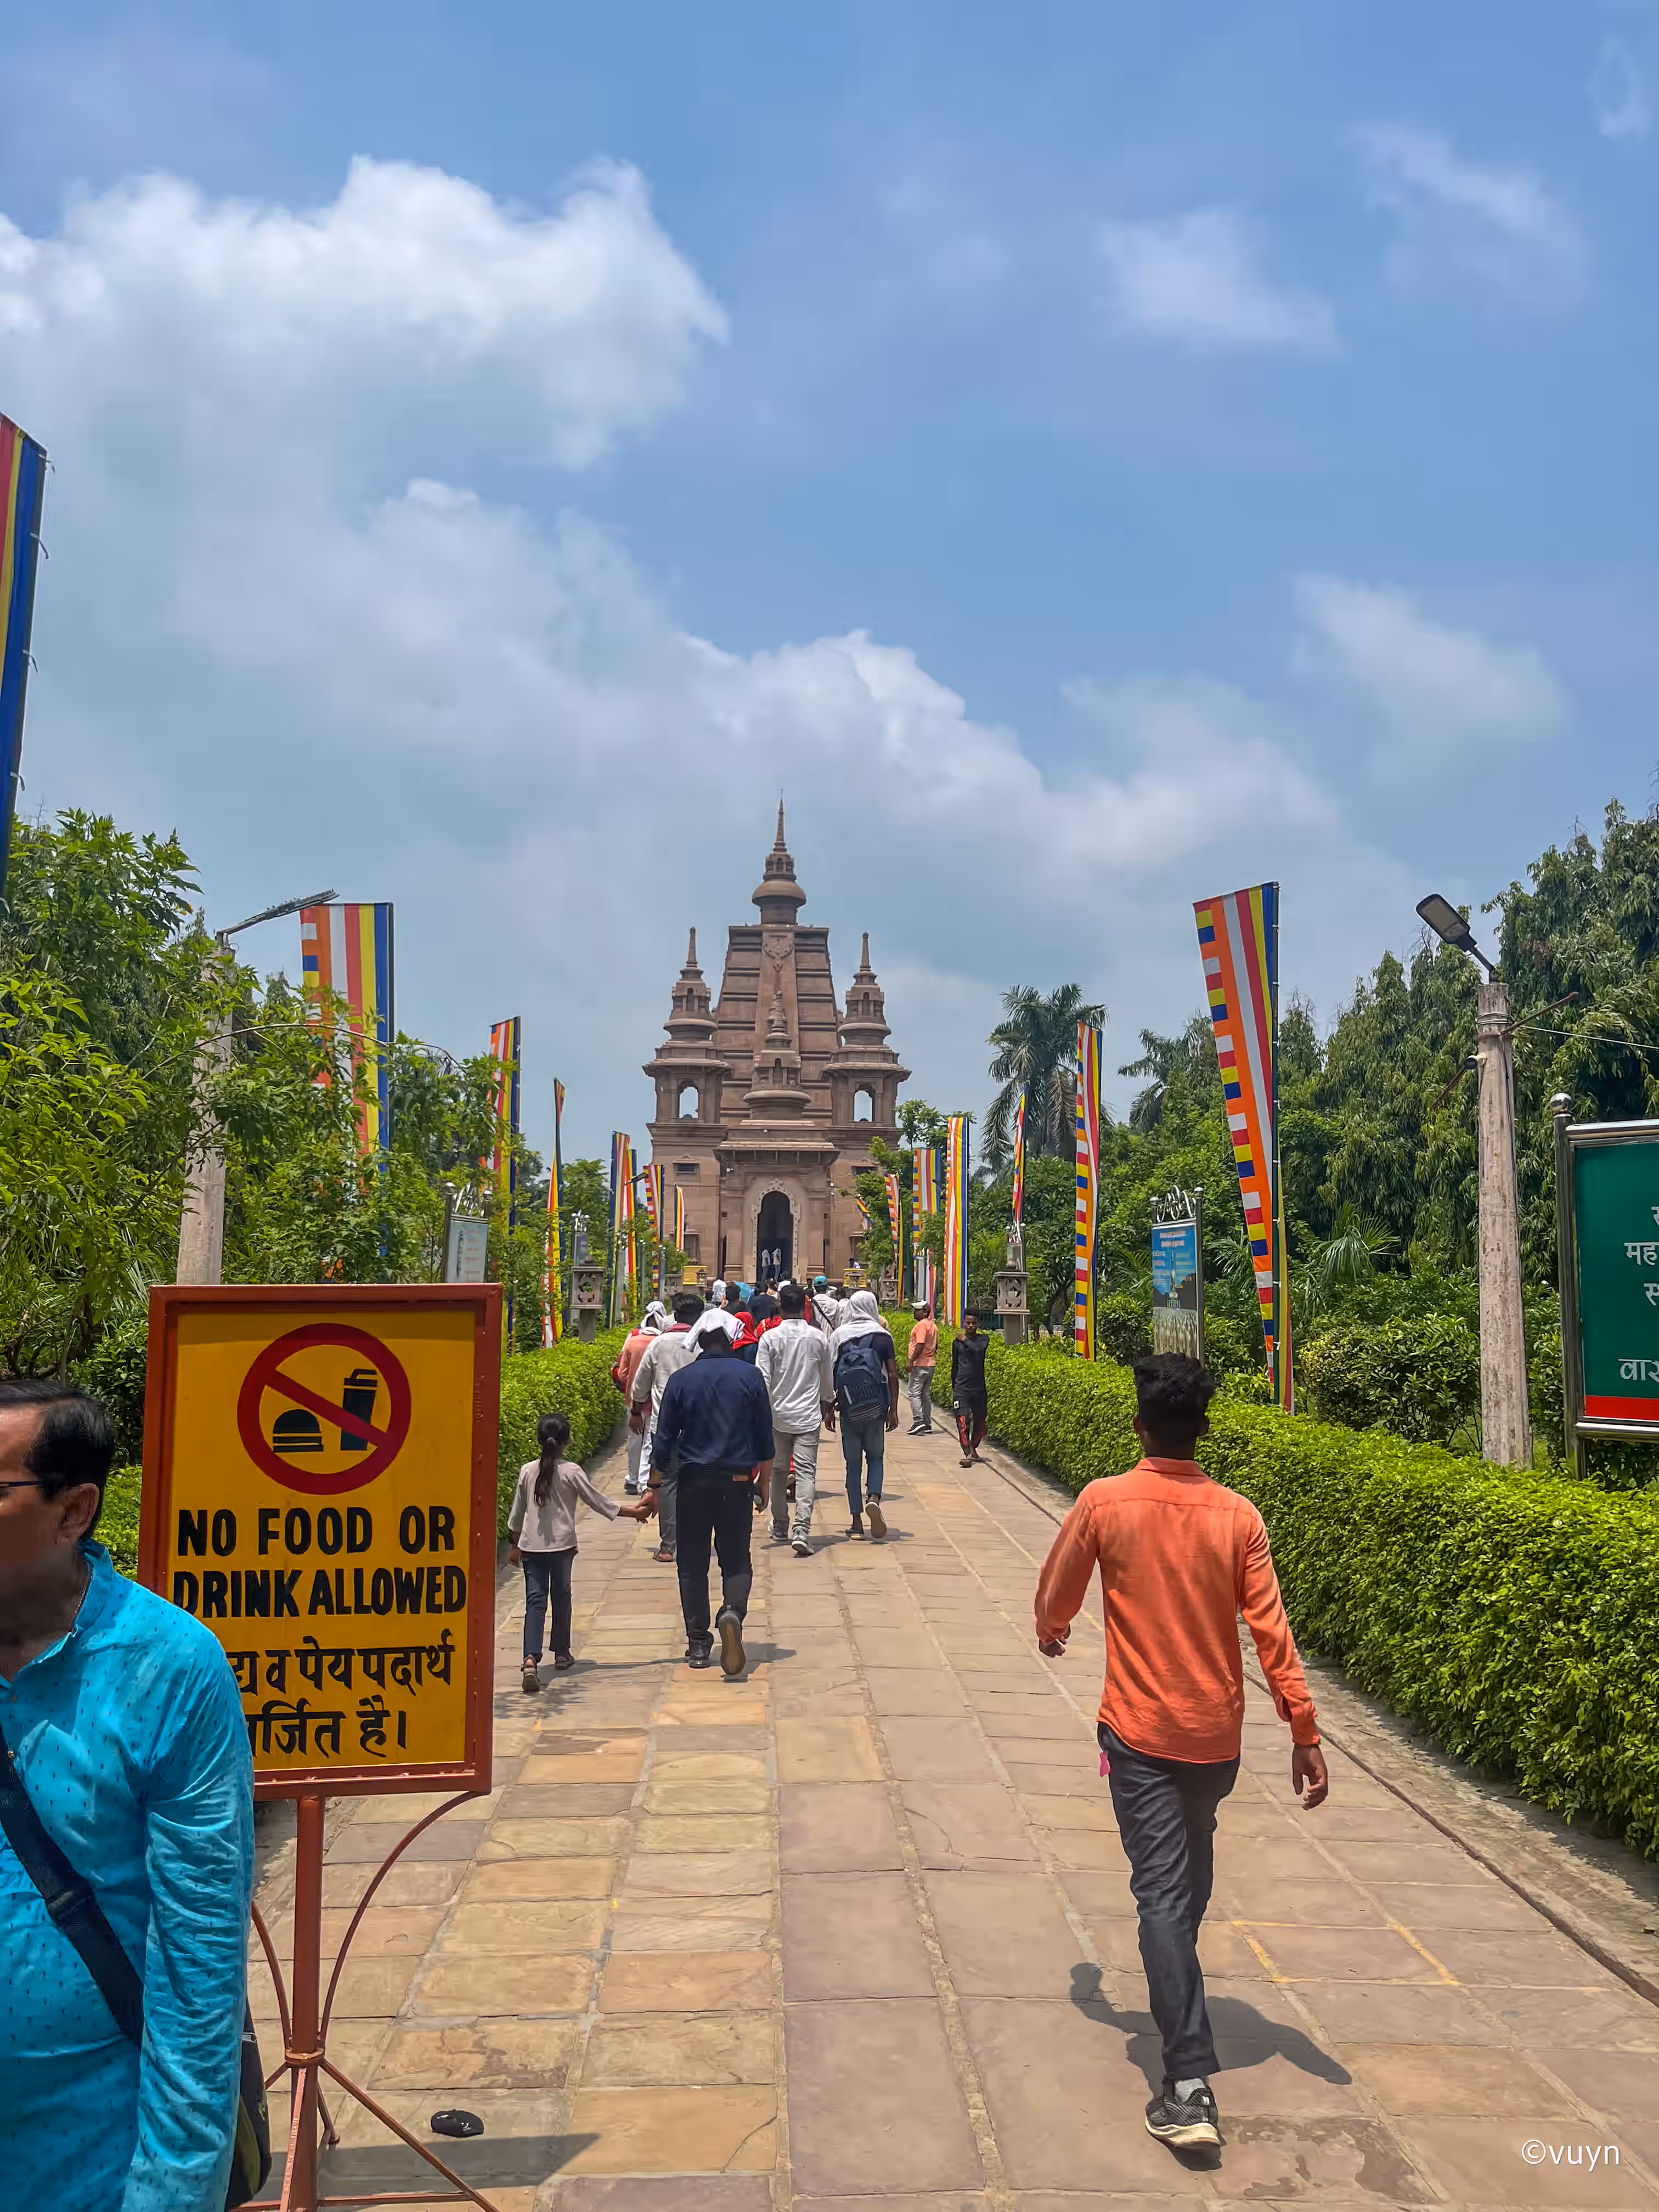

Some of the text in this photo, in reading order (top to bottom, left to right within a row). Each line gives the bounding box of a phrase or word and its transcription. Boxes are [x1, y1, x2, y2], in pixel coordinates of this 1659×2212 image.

[1624, 1242, 1659, 1266] मह
[178, 1505, 455, 1557] NO FOOD OR
[173, 1565, 467, 1618] DRINK ALLOWED
